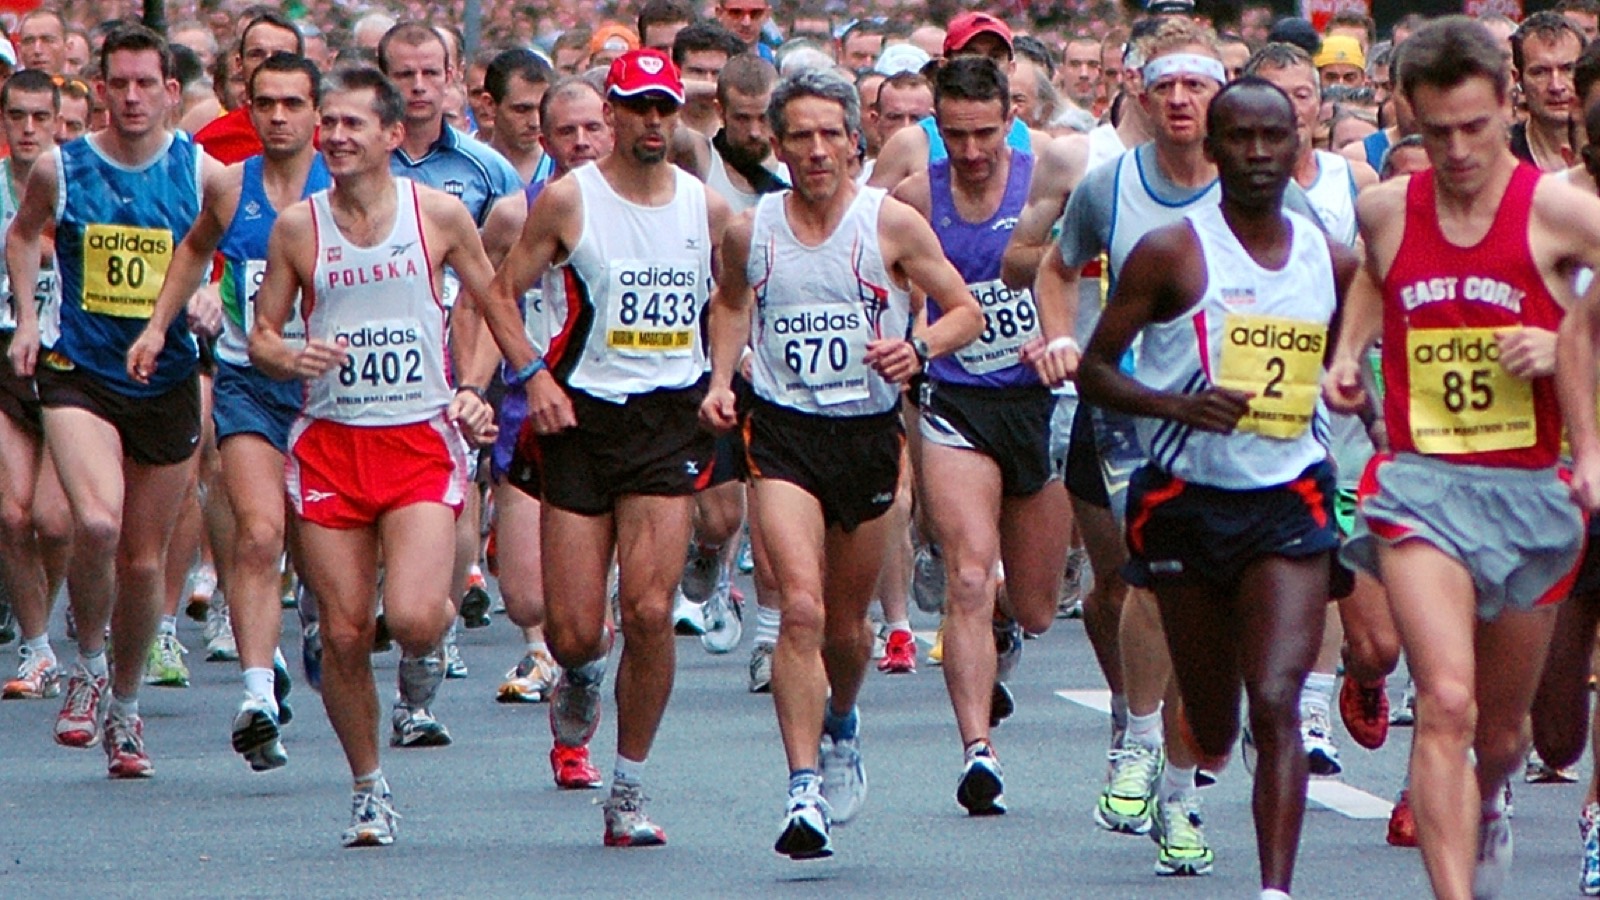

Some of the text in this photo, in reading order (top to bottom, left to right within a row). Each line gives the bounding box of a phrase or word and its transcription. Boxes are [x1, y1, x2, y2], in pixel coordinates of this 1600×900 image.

[89, 232, 167, 254] adidas
[107, 255, 145, 289] 80
[328, 259, 418, 289] POLSKA
[619, 267, 695, 286] adidas
[619, 291, 697, 327] 8433
[1400, 275, 1526, 314] EAST CORK
[335, 327, 418, 348] adidas
[774, 311, 860, 335] adidas
[1231, 324, 1323, 353] adidas
[784, 336, 848, 375] 670
[1415, 338, 1499, 364] adida
[339, 348, 423, 387] 8402
[1263, 356, 1286, 398] 2
[1443, 369, 1494, 413] 85
